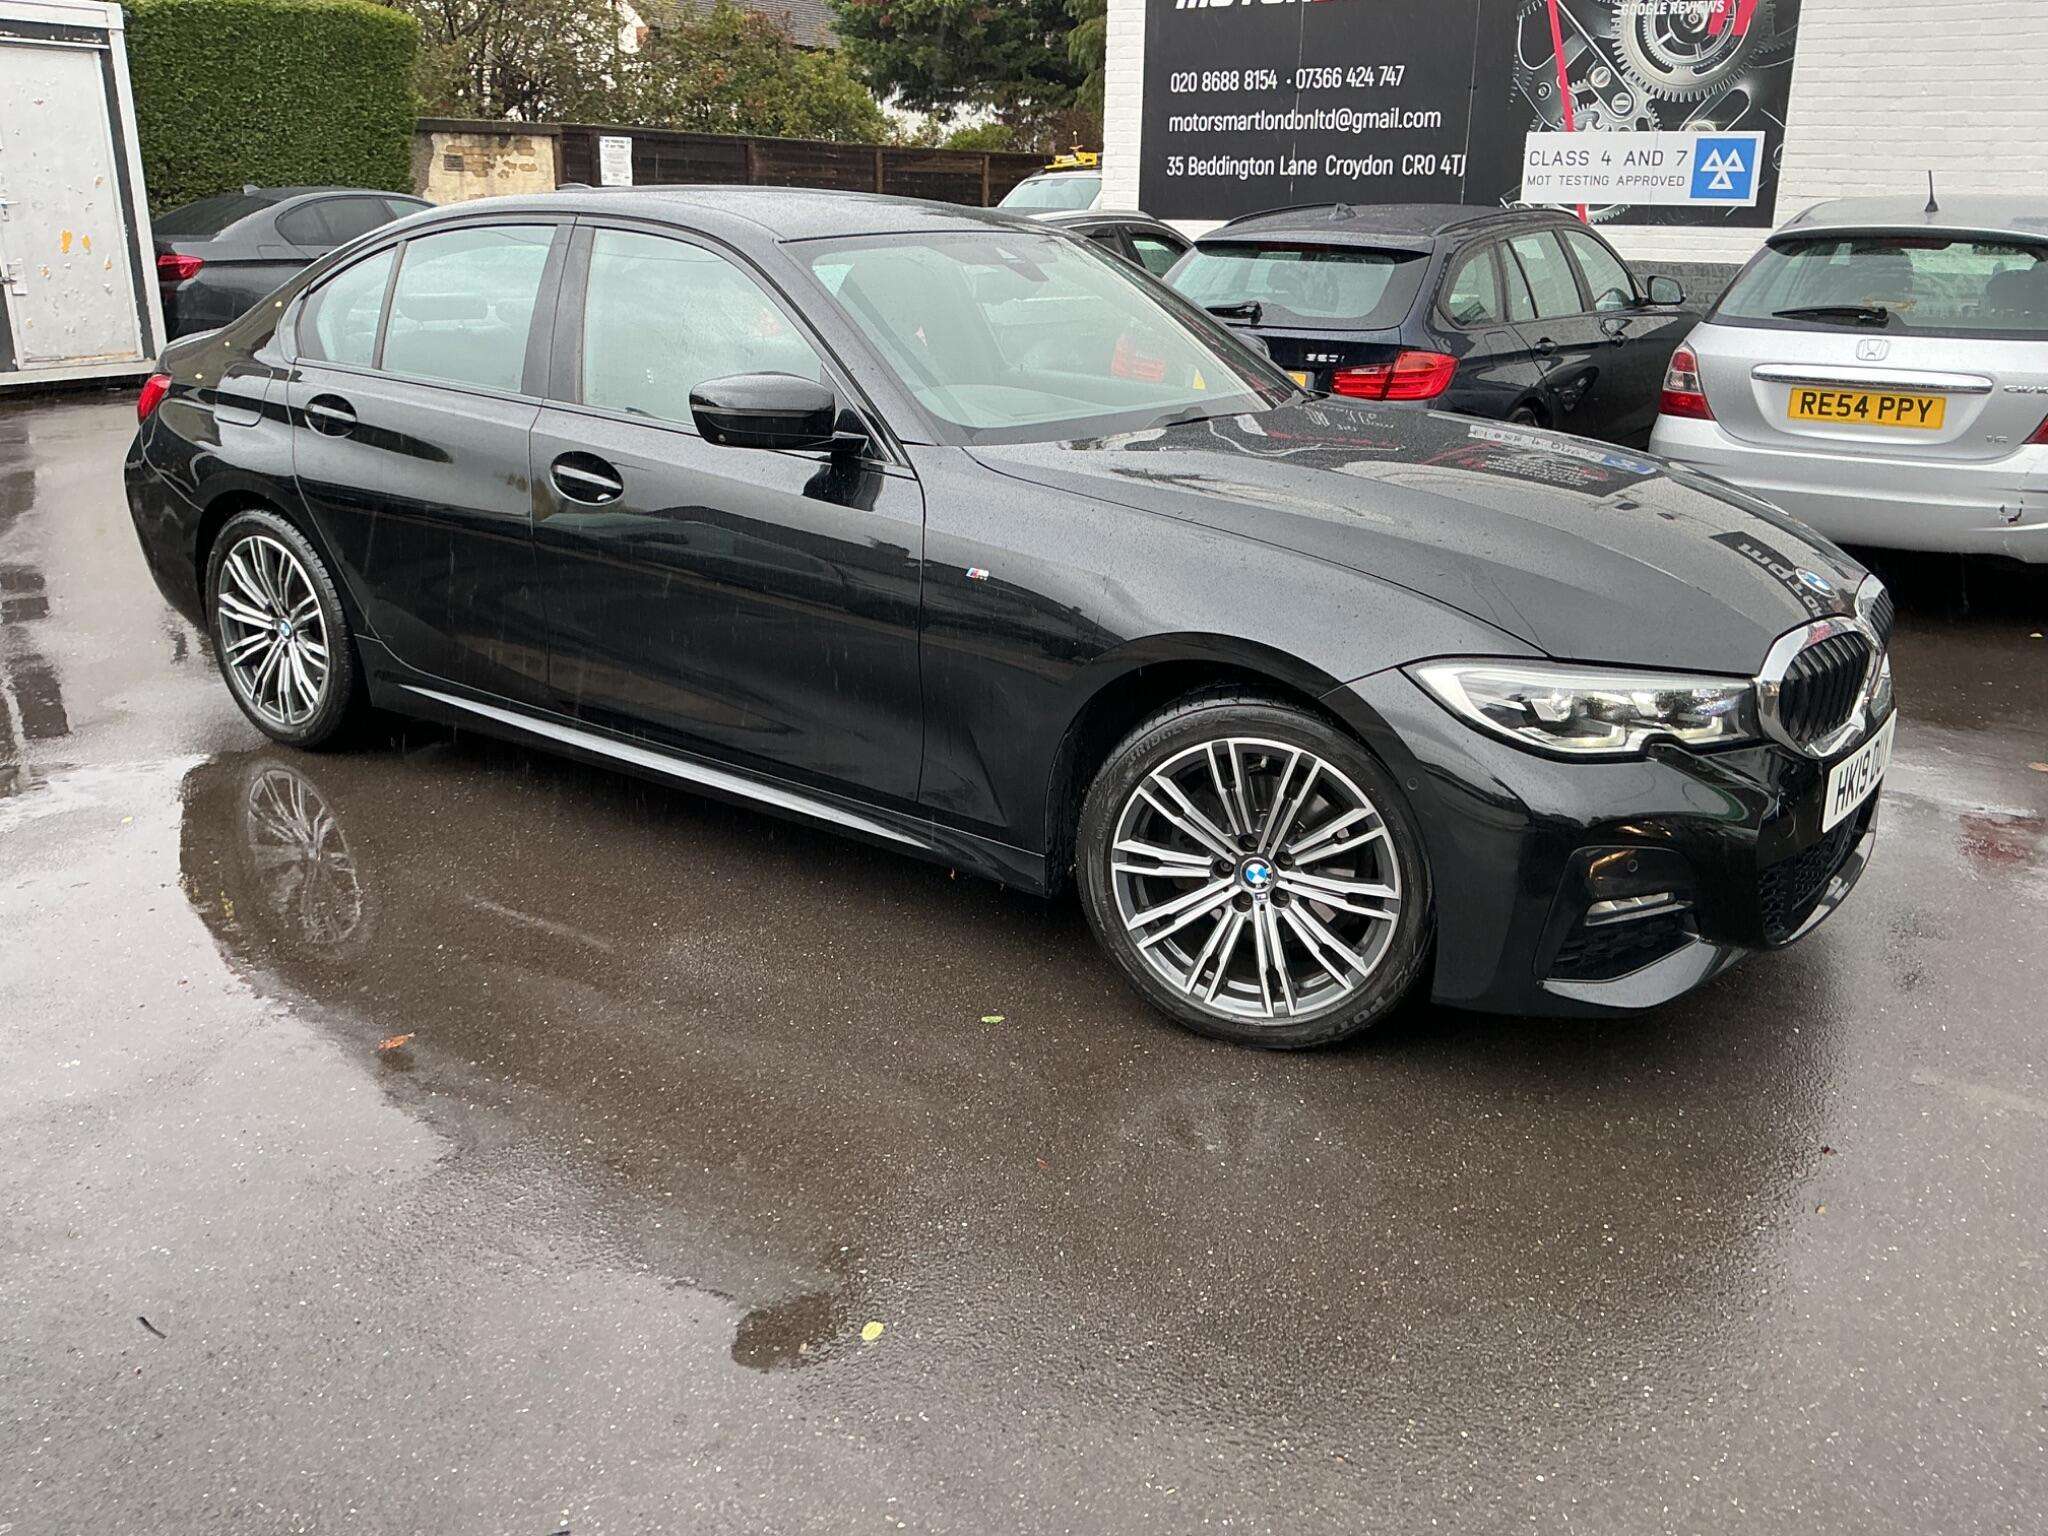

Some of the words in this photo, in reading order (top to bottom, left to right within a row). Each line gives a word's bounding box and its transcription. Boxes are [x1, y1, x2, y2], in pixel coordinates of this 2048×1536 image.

[1621, 2, 1667, 15] GOOGLE
[1670, 1, 1725, 14] REVIEWS
[1170, 72, 1198, 93] 020
[1201, 71, 1240, 92] 8688
[1243, 69, 1278, 91] 8154
[1295, 67, 1342, 89] 07366
[1346, 67, 1374, 88] 424
[1378, 65, 1406, 87] 747
[1168, 107, 1442, 134] motorsmartlondonltd@gmail.com
[1166, 156, 1184, 176] 35
[1187, 155, 1275, 180] Beddington
[1279, 155, 1318, 176] Lane
[1325, 155, 1394, 180] Croydon
[1439, 154, 1467, 177] 4TJ
[1529, 150, 1590, 167] CLASS
[1601, 150, 1612, 167] 4
[1623, 150, 1665, 167] AND
[1676, 150, 1688, 167] 7
[1527, 174, 1552, 186] MOT
[1559, 174, 1610, 187] TESTING
[1615, 174, 1685, 187] APPROVED
[1800, 391, 1869, 418] RE54
[1877, 396, 1933, 423] PPY
